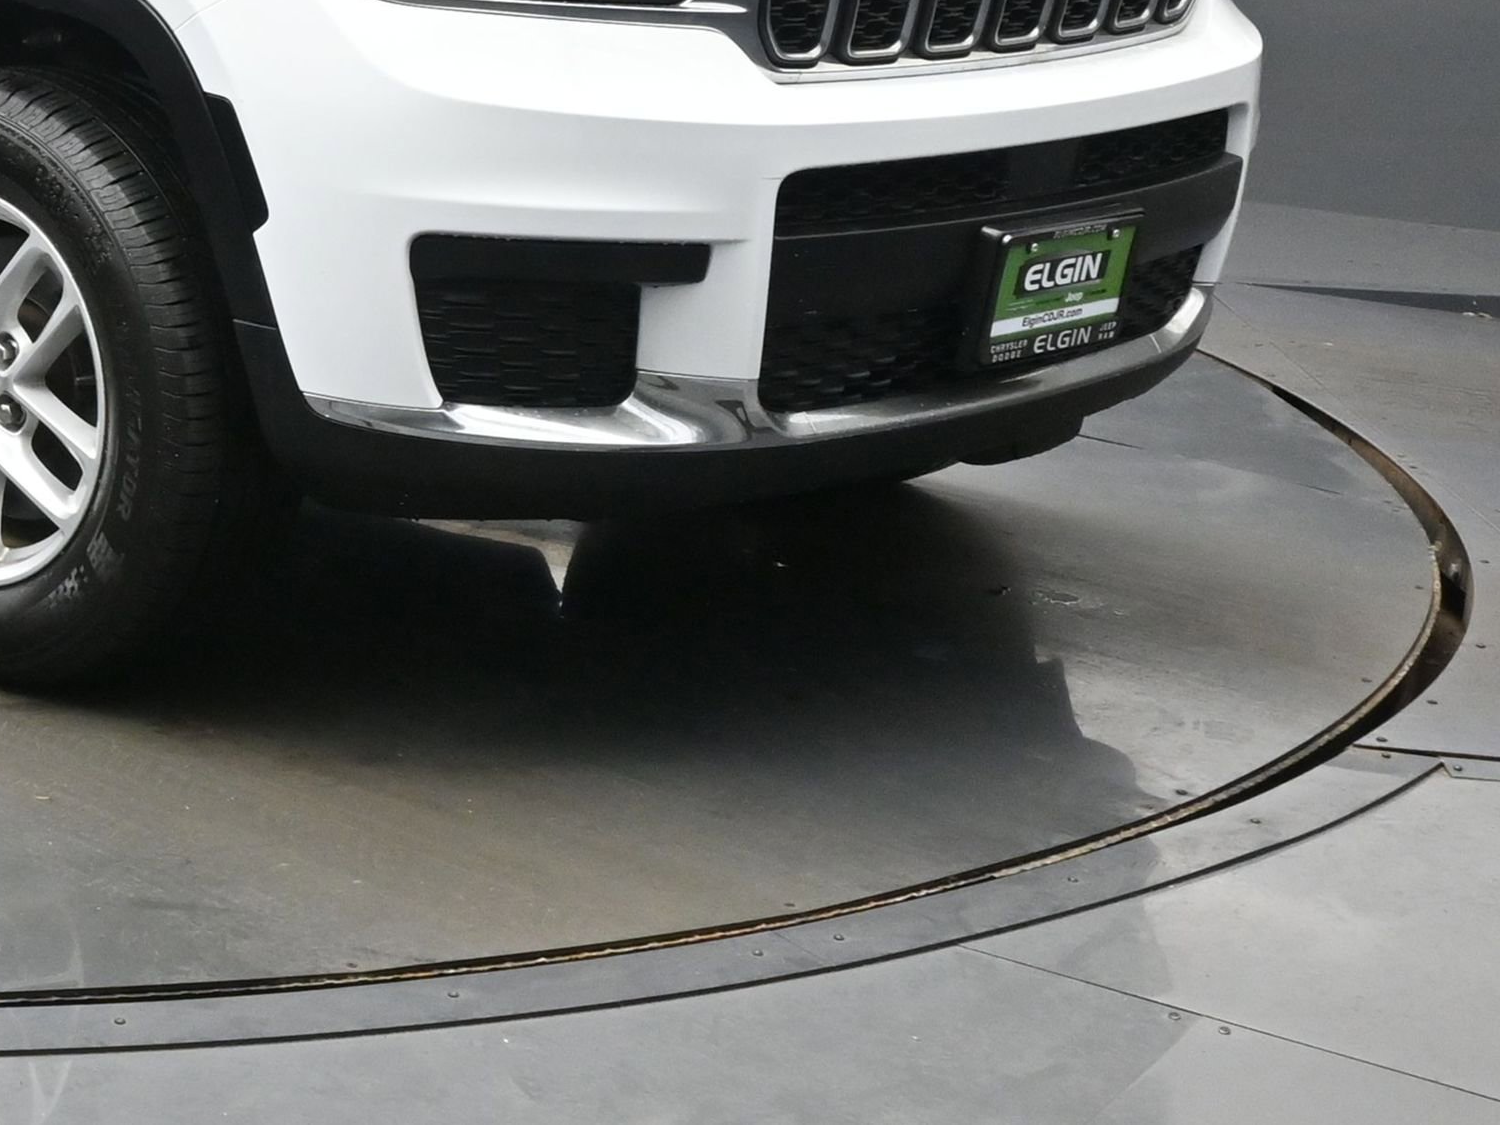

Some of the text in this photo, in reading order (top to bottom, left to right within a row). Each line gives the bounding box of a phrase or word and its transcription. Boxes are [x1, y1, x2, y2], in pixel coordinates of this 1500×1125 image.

[1023, 252, 1103, 291] ELGIN
[1064, 291, 1084, 303] Jeep
[1022, 307, 1084, 328] ElginCDJR.com
[990, 338, 1028, 354] CHRYSLER
[1033, 326, 1092, 354] ELGIN
[992, 350, 1021, 363] DODGE
